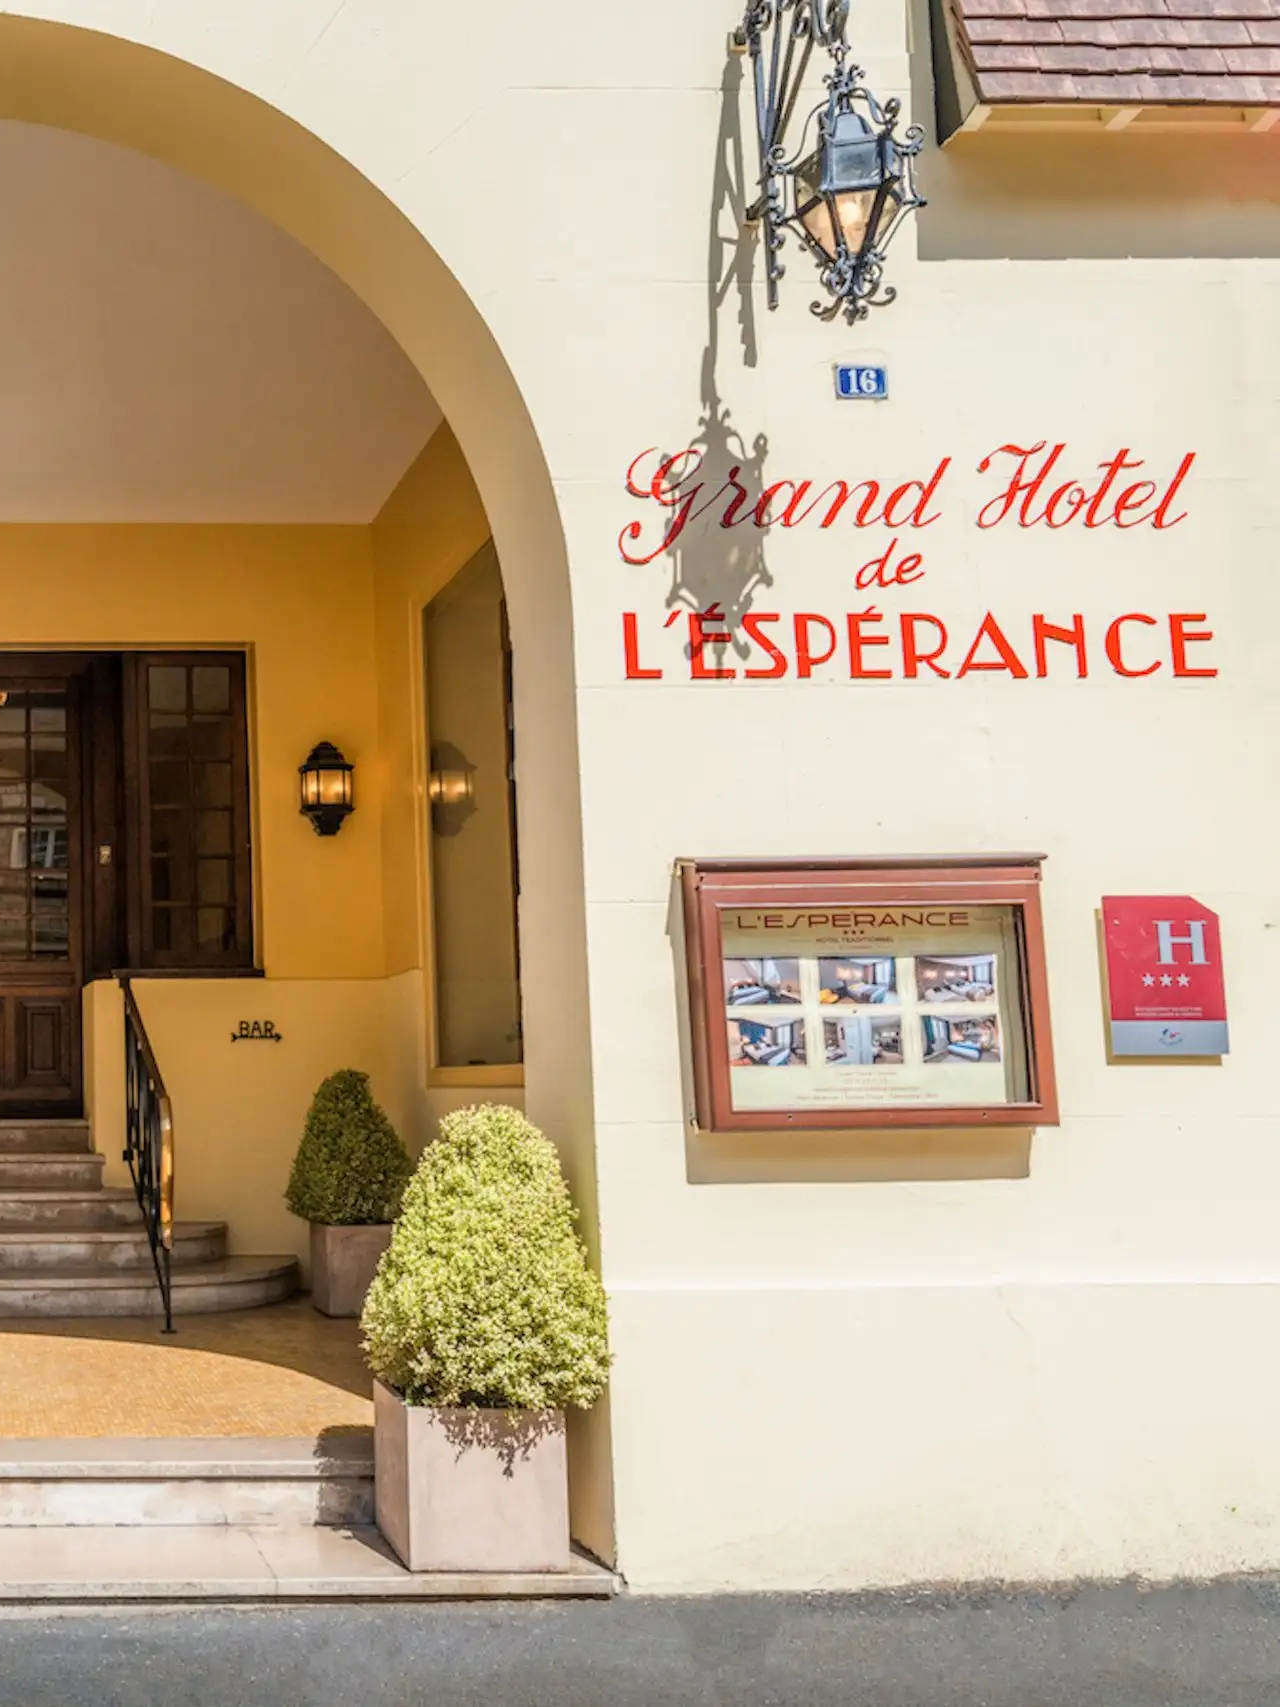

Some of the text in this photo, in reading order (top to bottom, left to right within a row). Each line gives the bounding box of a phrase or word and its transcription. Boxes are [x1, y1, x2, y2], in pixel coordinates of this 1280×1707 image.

[848, 368, 878, 394] 16
[618, 440, 1197, 564] Grand Hotel
[854, 538, 926, 590] de
[1152, 919, 1212, 965] H
[239, 1020, 275, 1038] BAR
